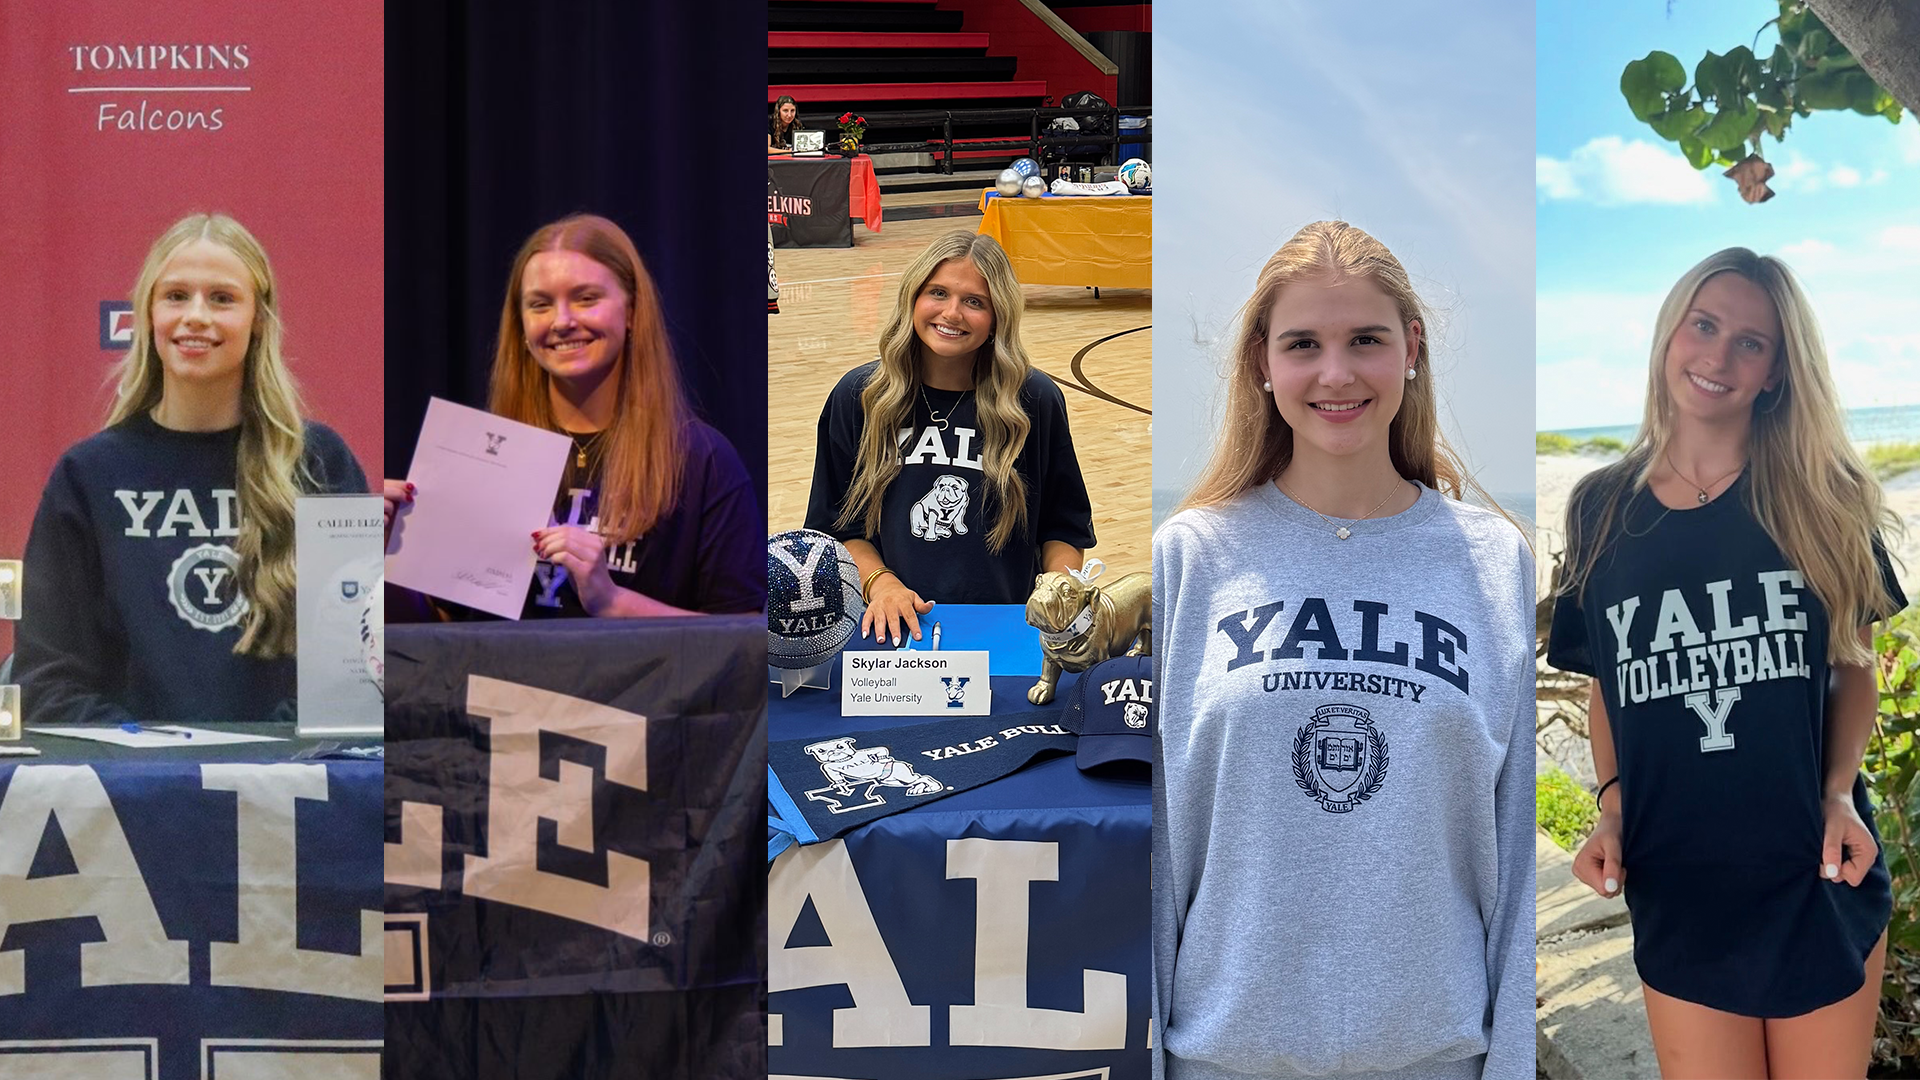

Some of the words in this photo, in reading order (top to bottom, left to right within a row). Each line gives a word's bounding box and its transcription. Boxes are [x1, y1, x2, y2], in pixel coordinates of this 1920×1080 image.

[69, 44, 250, 71] TOMPKINS
[98, 100, 223, 132] Falcons
[897, 425, 984, 471] AL
[114, 488, 241, 538] YAL
[194, 567, 229, 604] Y
[768, 535, 834, 612] Y
[779, 611, 837, 633] YALE
[1606, 569, 1809, 664] YALE
[851, 657, 892, 671] Skylar
[895, 657, 948, 669] Jackson
[1217, 597, 1469, 696] YALE
[851, 677, 897, 689] Volleyball
[1262, 671, 1426, 704] UNIVERSITY
[1616, 632, 1811, 708] VOLLEYBALL
[851, 693, 872, 703] Yale
[875, 692, 923, 705] University
[1318, 707, 1331, 715] LUX
[1340, 707, 1368, 719] VERITAS
[1684, 686, 1742, 753] Y
[921, 735, 999, 761] YALE
[999, 724, 1071, 740] BULL
[1326, 802, 1349, 811] YALE
[768, 838, 1152, 1049] AL
